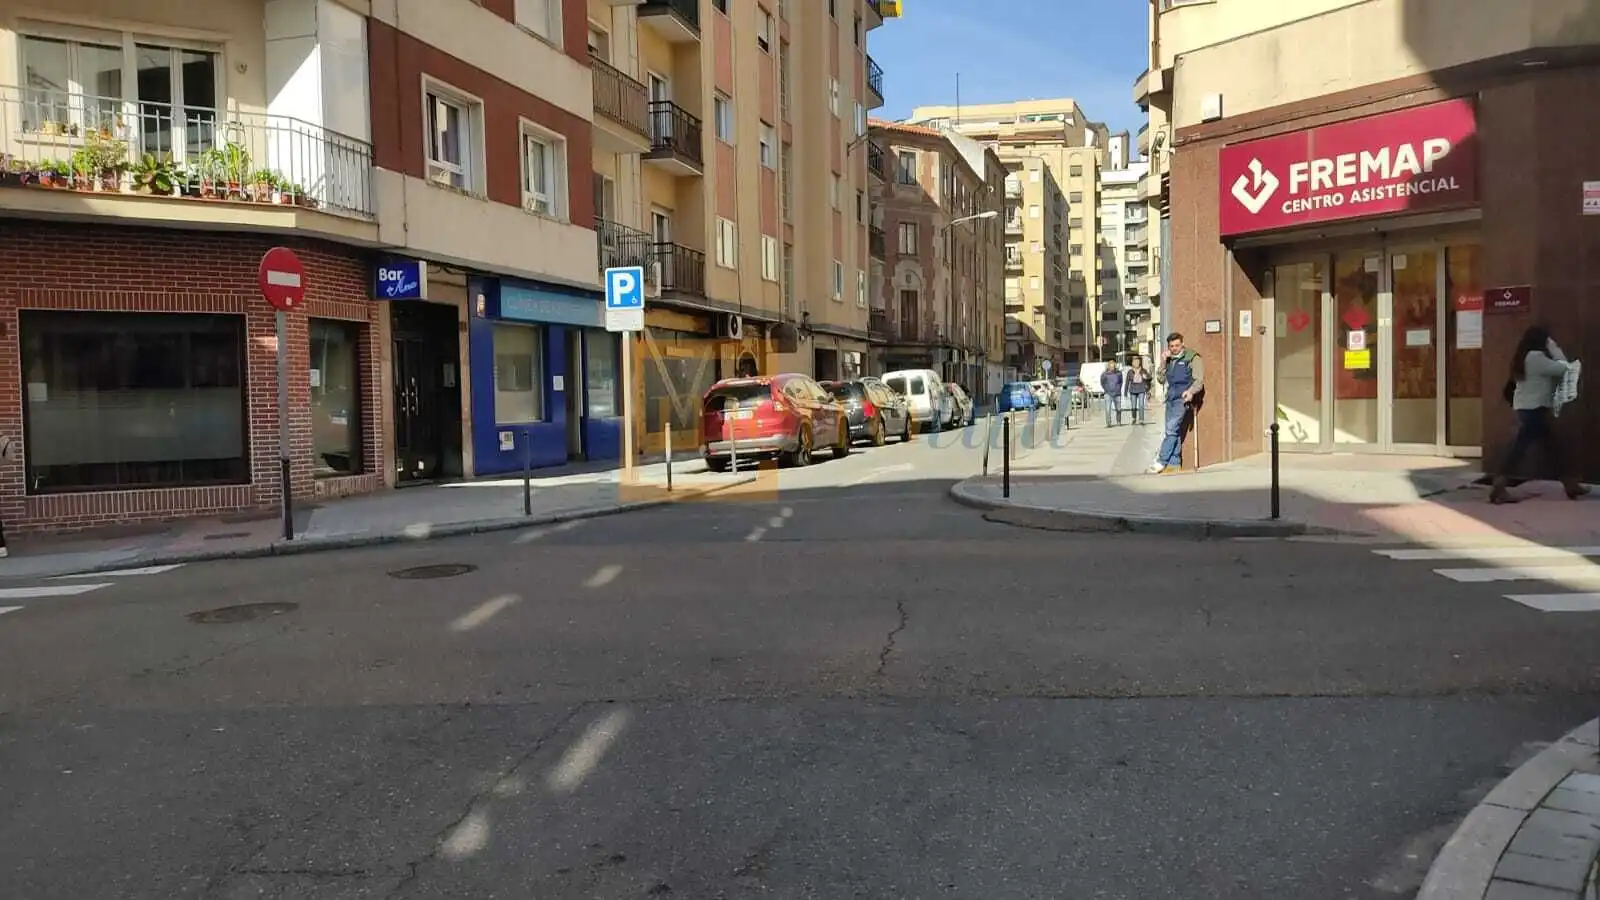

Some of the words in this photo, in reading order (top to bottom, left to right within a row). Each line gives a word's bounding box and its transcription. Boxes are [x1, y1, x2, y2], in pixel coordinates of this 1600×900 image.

[1288, 137, 1452, 194] FREMAP
[1282, 192, 1345, 215] CENTRO
[1350, 176, 1459, 205] ASISTENCIAL
[378, 268, 404, 281] Bar
[612, 272, 635, 304] P
